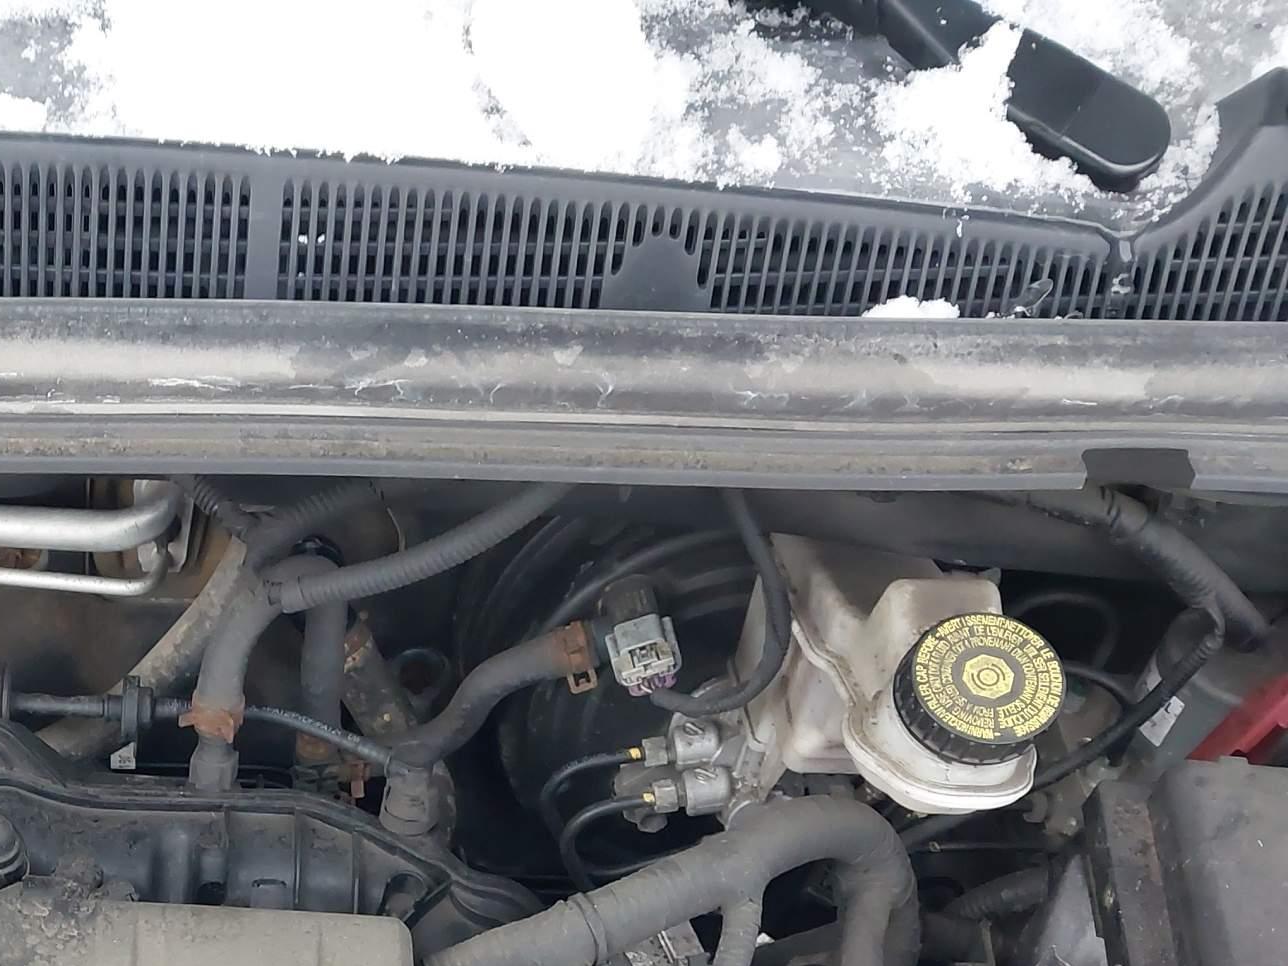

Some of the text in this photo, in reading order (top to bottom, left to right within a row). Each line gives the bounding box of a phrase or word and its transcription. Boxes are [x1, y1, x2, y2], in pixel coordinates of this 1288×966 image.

[917, 635, 938, 664] BEFORE
[1040, 648, 1054, 660] LE
[916, 665, 928, 682] CAP
[935, 691, 953, 708] USE
